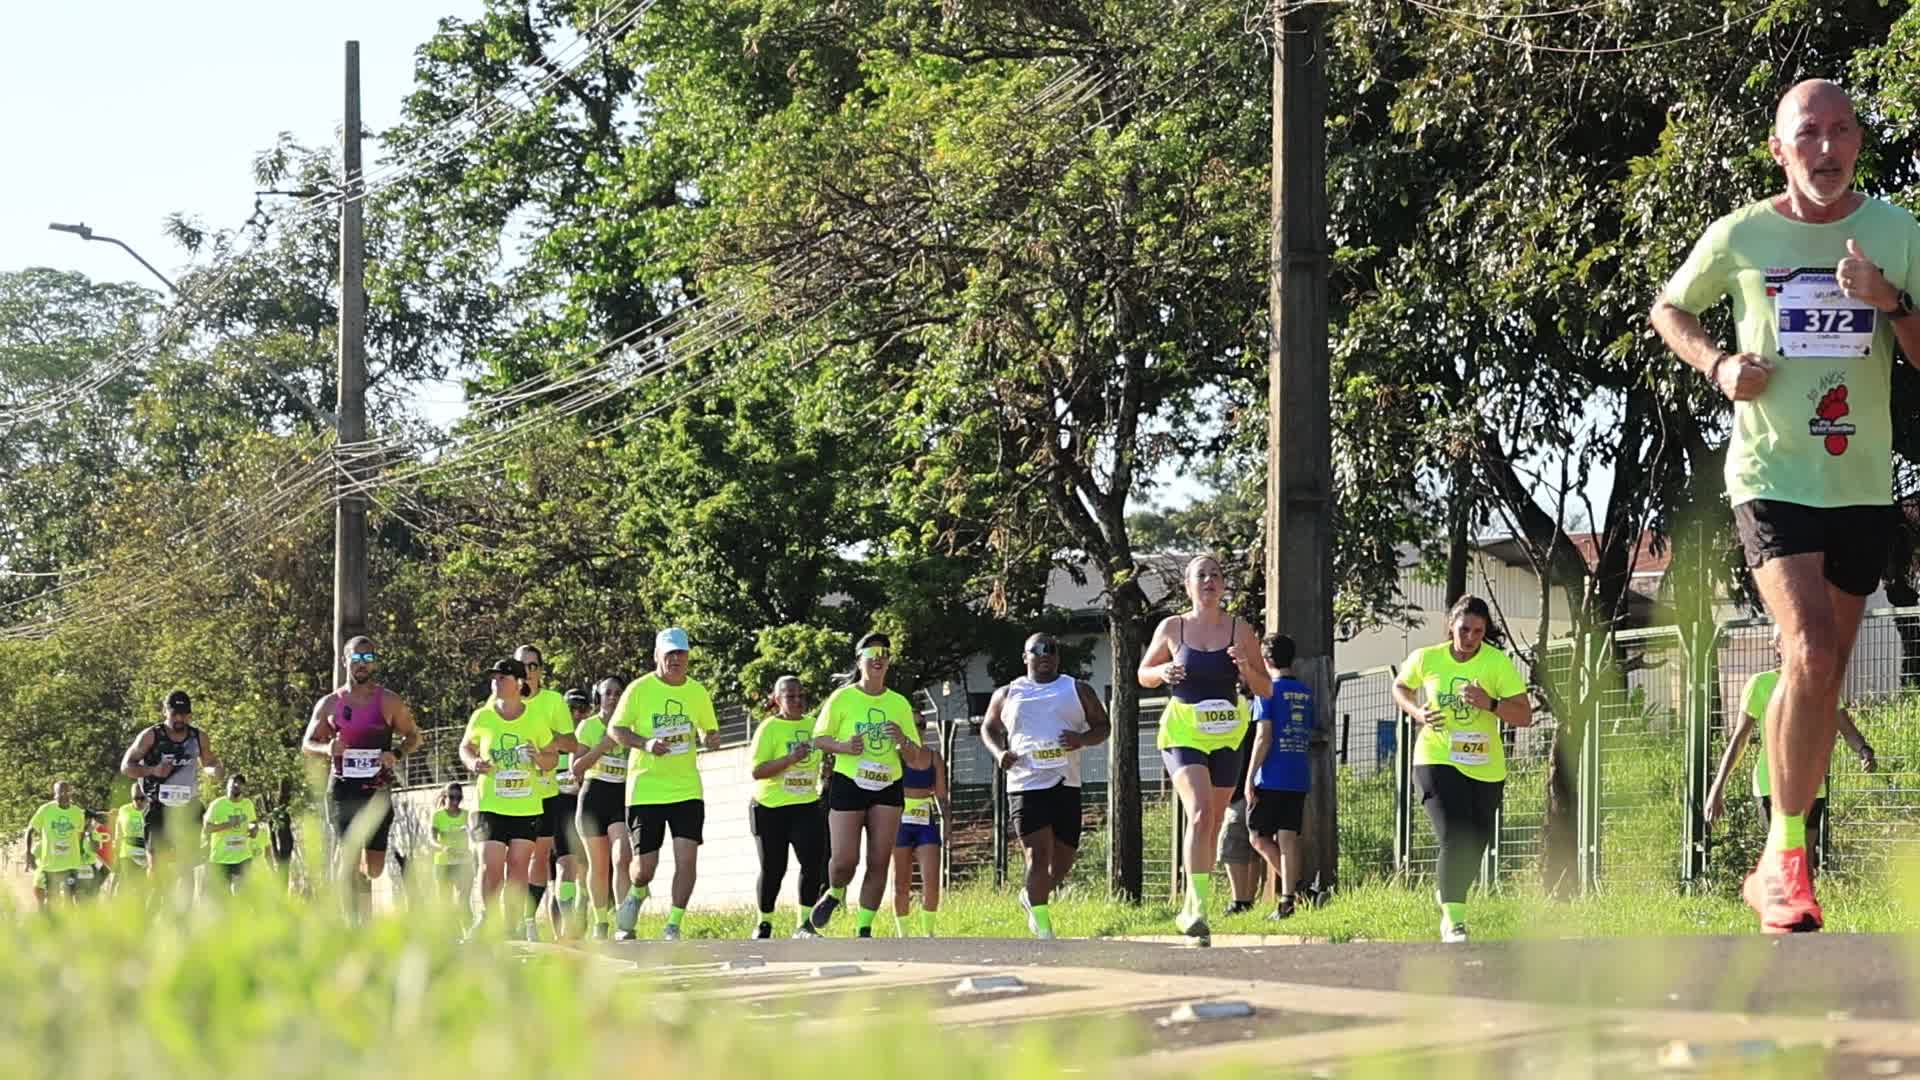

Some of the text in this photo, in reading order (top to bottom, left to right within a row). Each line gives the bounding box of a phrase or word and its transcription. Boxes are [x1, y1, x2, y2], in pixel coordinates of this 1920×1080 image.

[1804, 310, 1854, 332] 372
[1204, 710, 1235, 721] 1068
[1038, 748, 1062, 759] 1058
[1463, 743, 1484, 753] 674
[355, 757, 372, 768] 125
[864, 770, 889, 782] 1066
